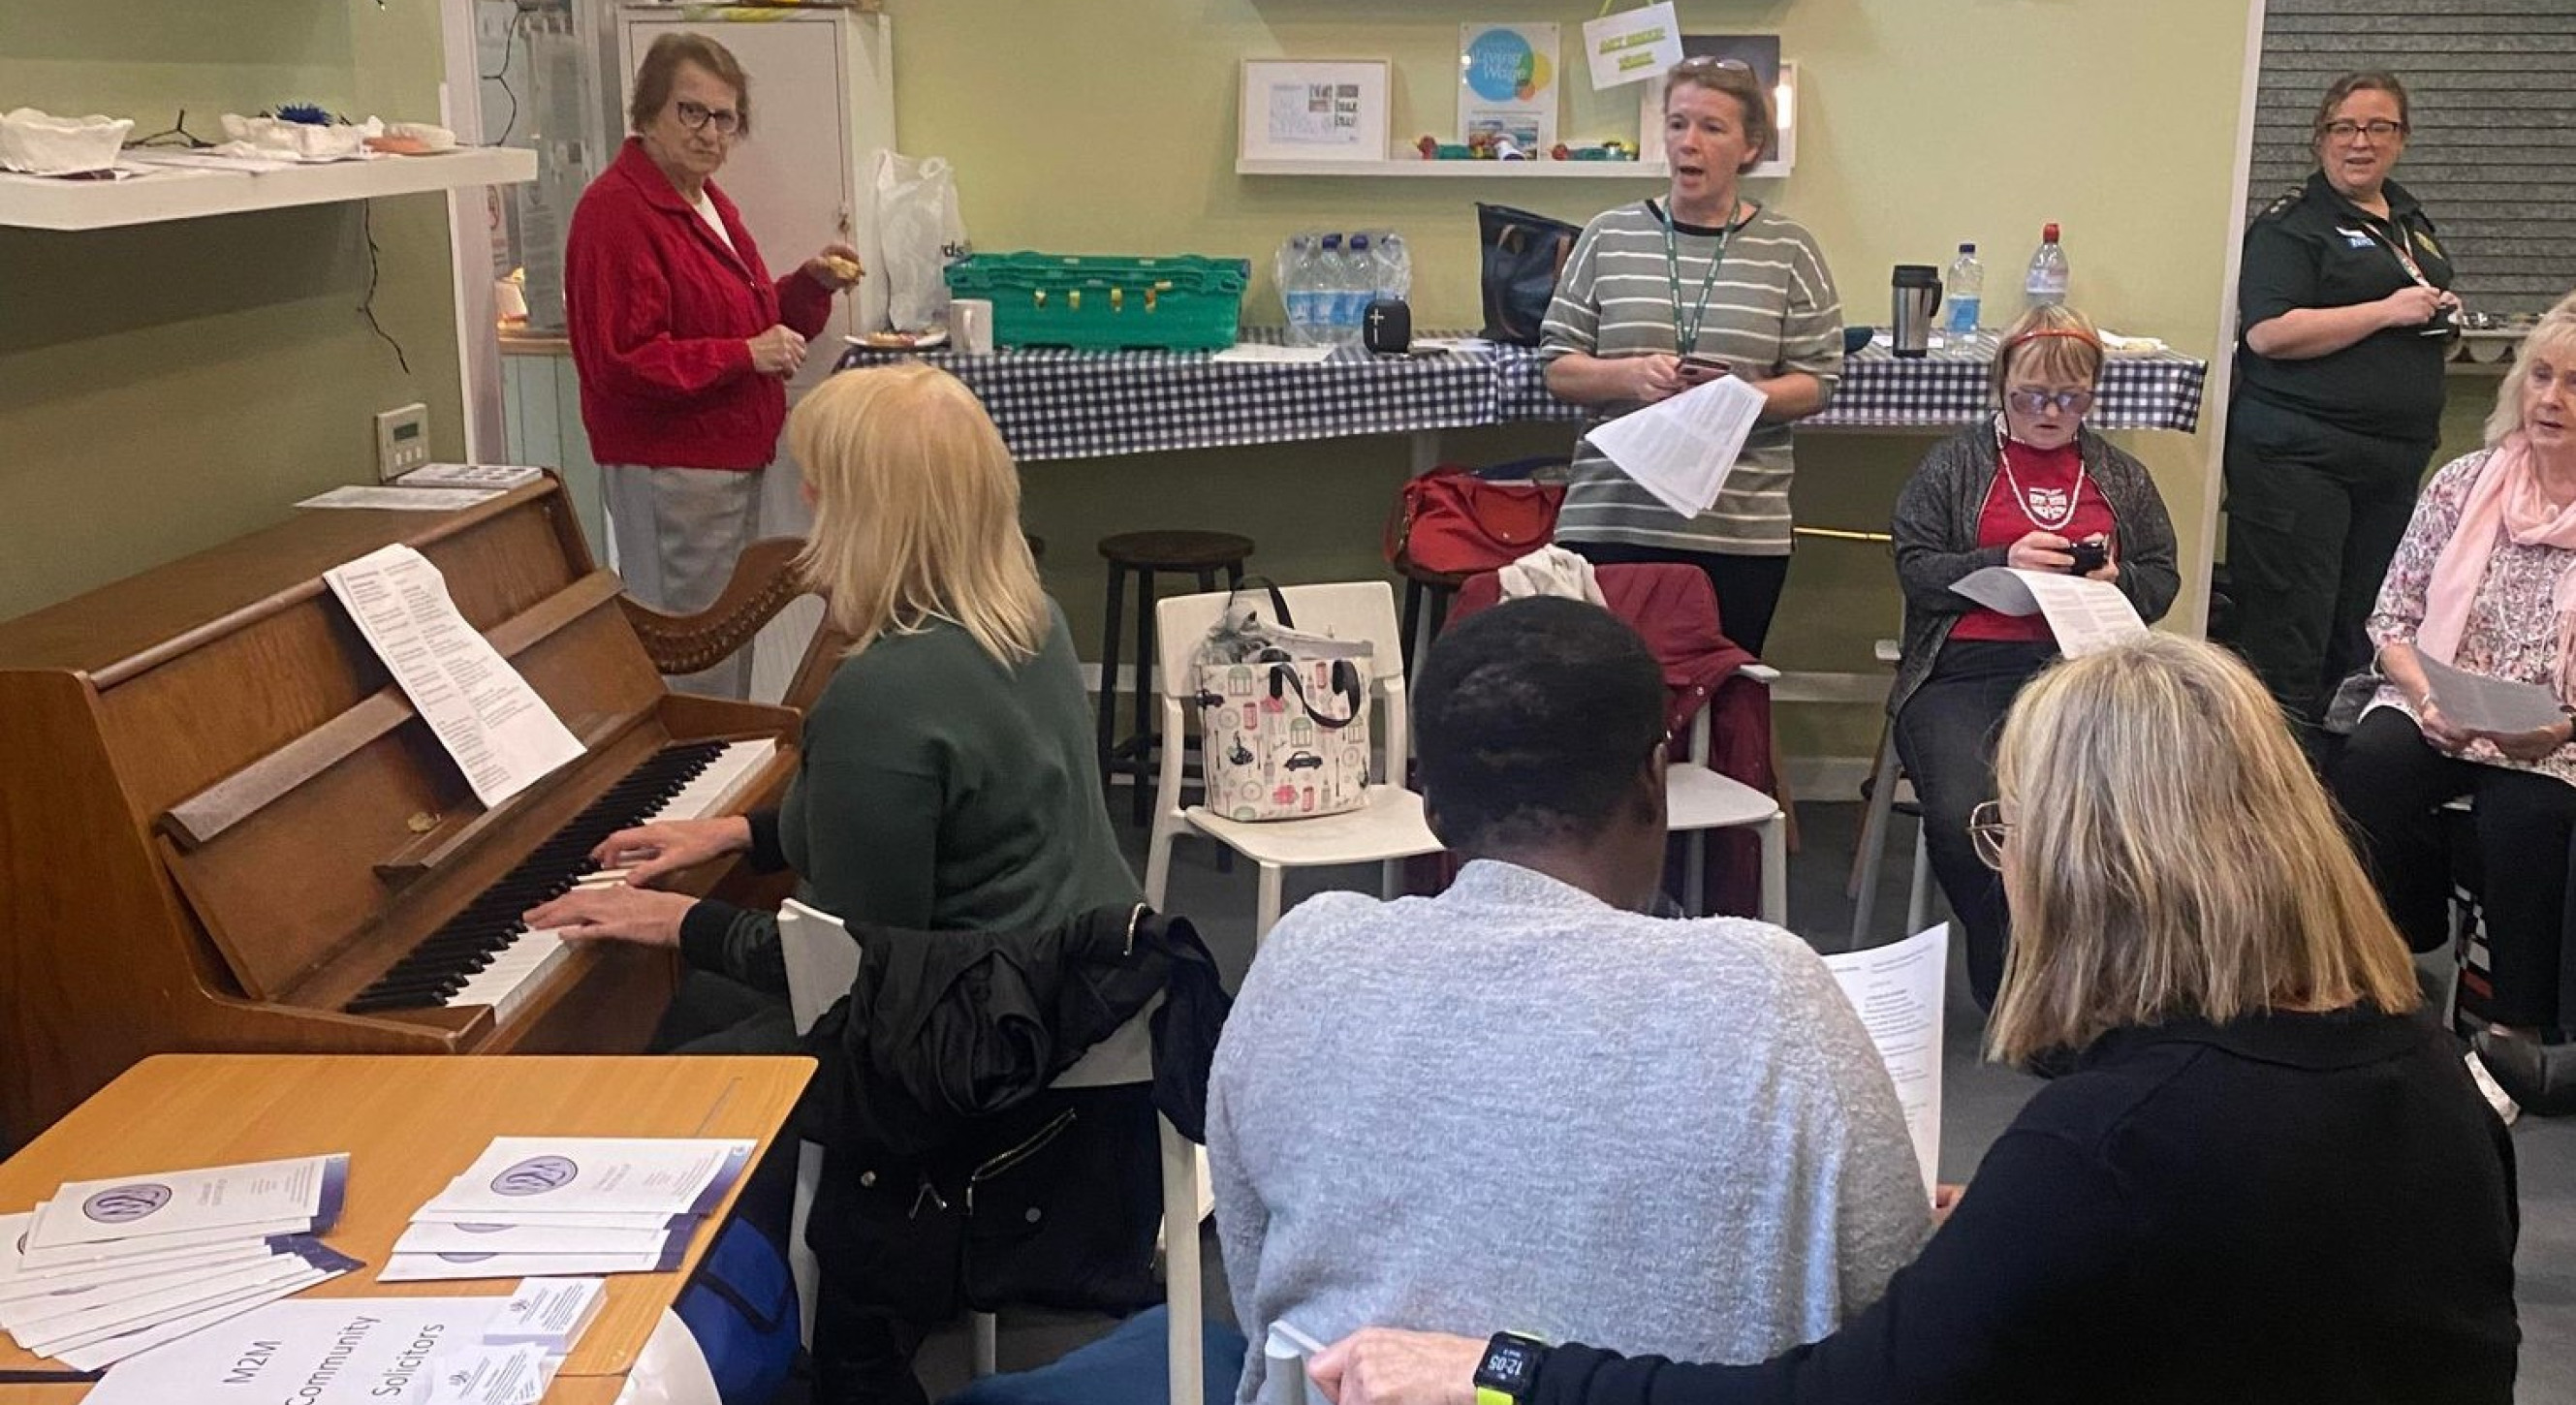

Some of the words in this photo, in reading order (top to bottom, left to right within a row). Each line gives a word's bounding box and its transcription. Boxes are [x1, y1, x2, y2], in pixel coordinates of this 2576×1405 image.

[1473, 47, 1522, 70] Living
[1484, 66, 1525, 89] Wage
[223, 1339, 282, 1384] M2M
[371, 1324, 445, 1396] Solicitors
